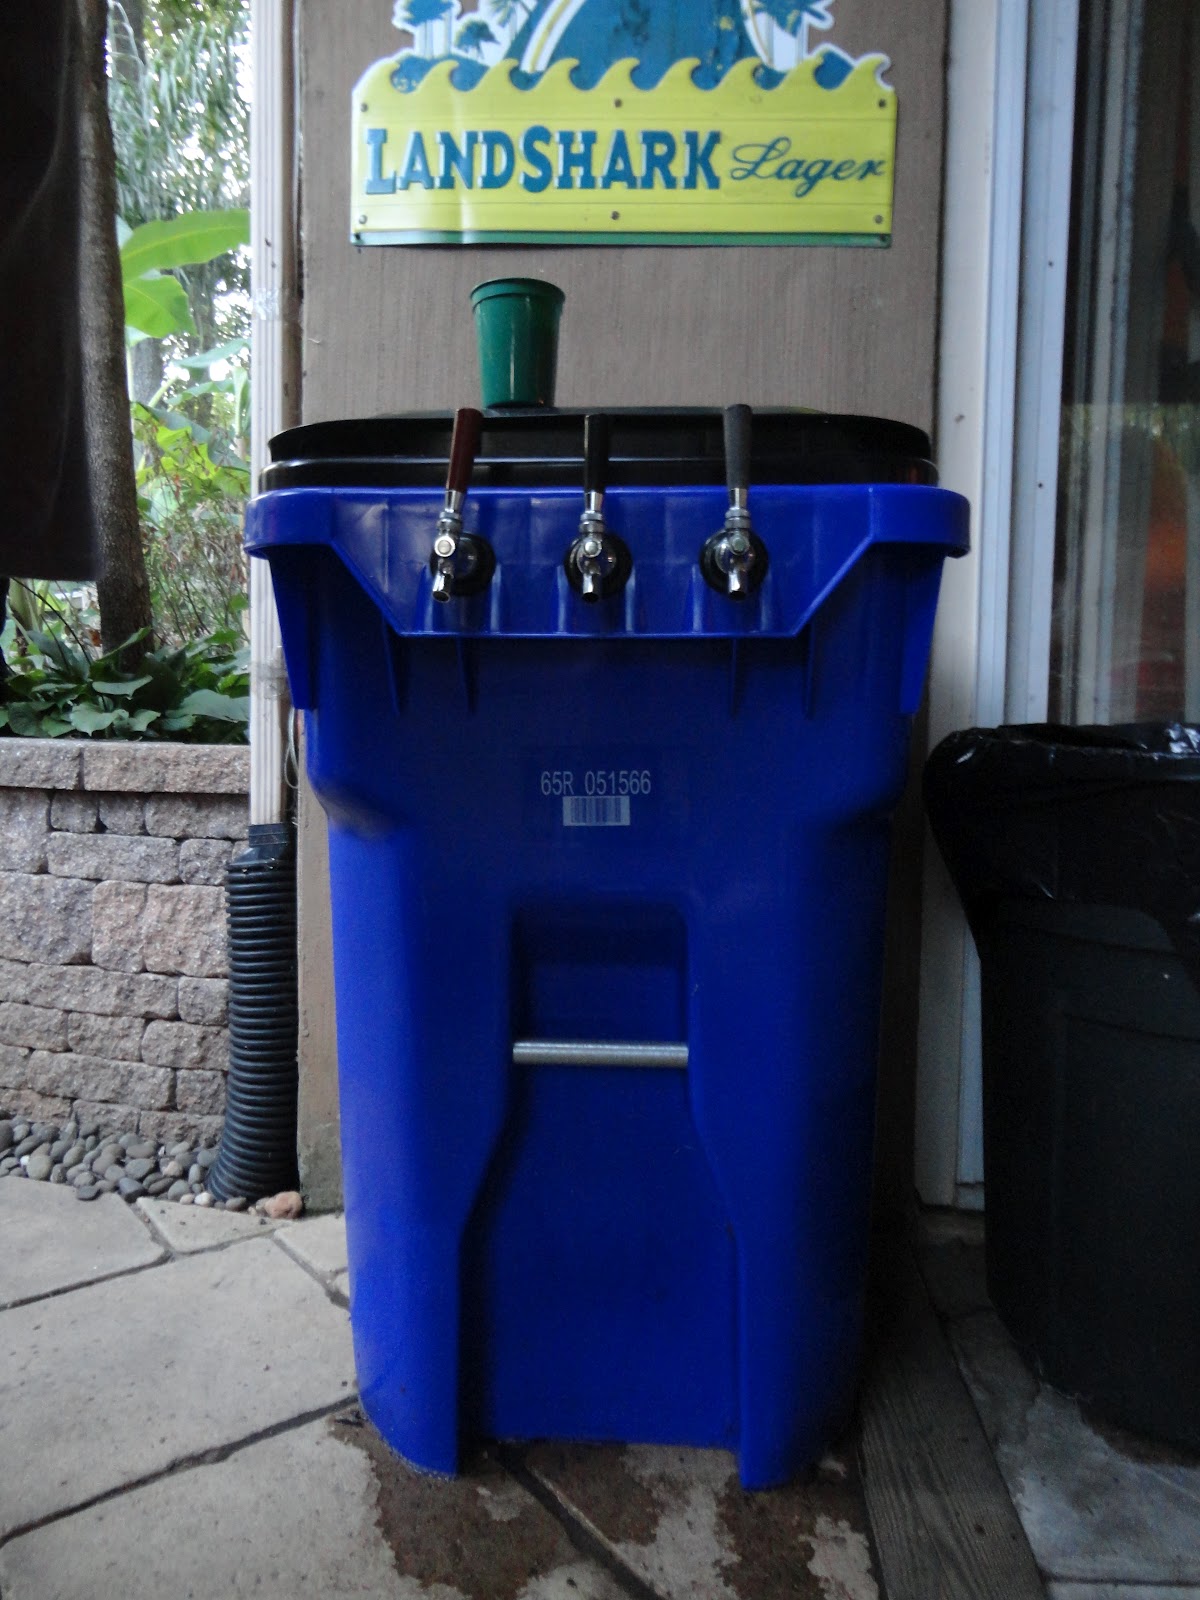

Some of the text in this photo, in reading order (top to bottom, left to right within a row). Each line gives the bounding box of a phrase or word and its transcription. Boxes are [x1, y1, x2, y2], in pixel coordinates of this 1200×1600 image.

[366, 125, 886, 198] LANDSHARK Lager
[540, 770, 651, 795] 65R 051566
